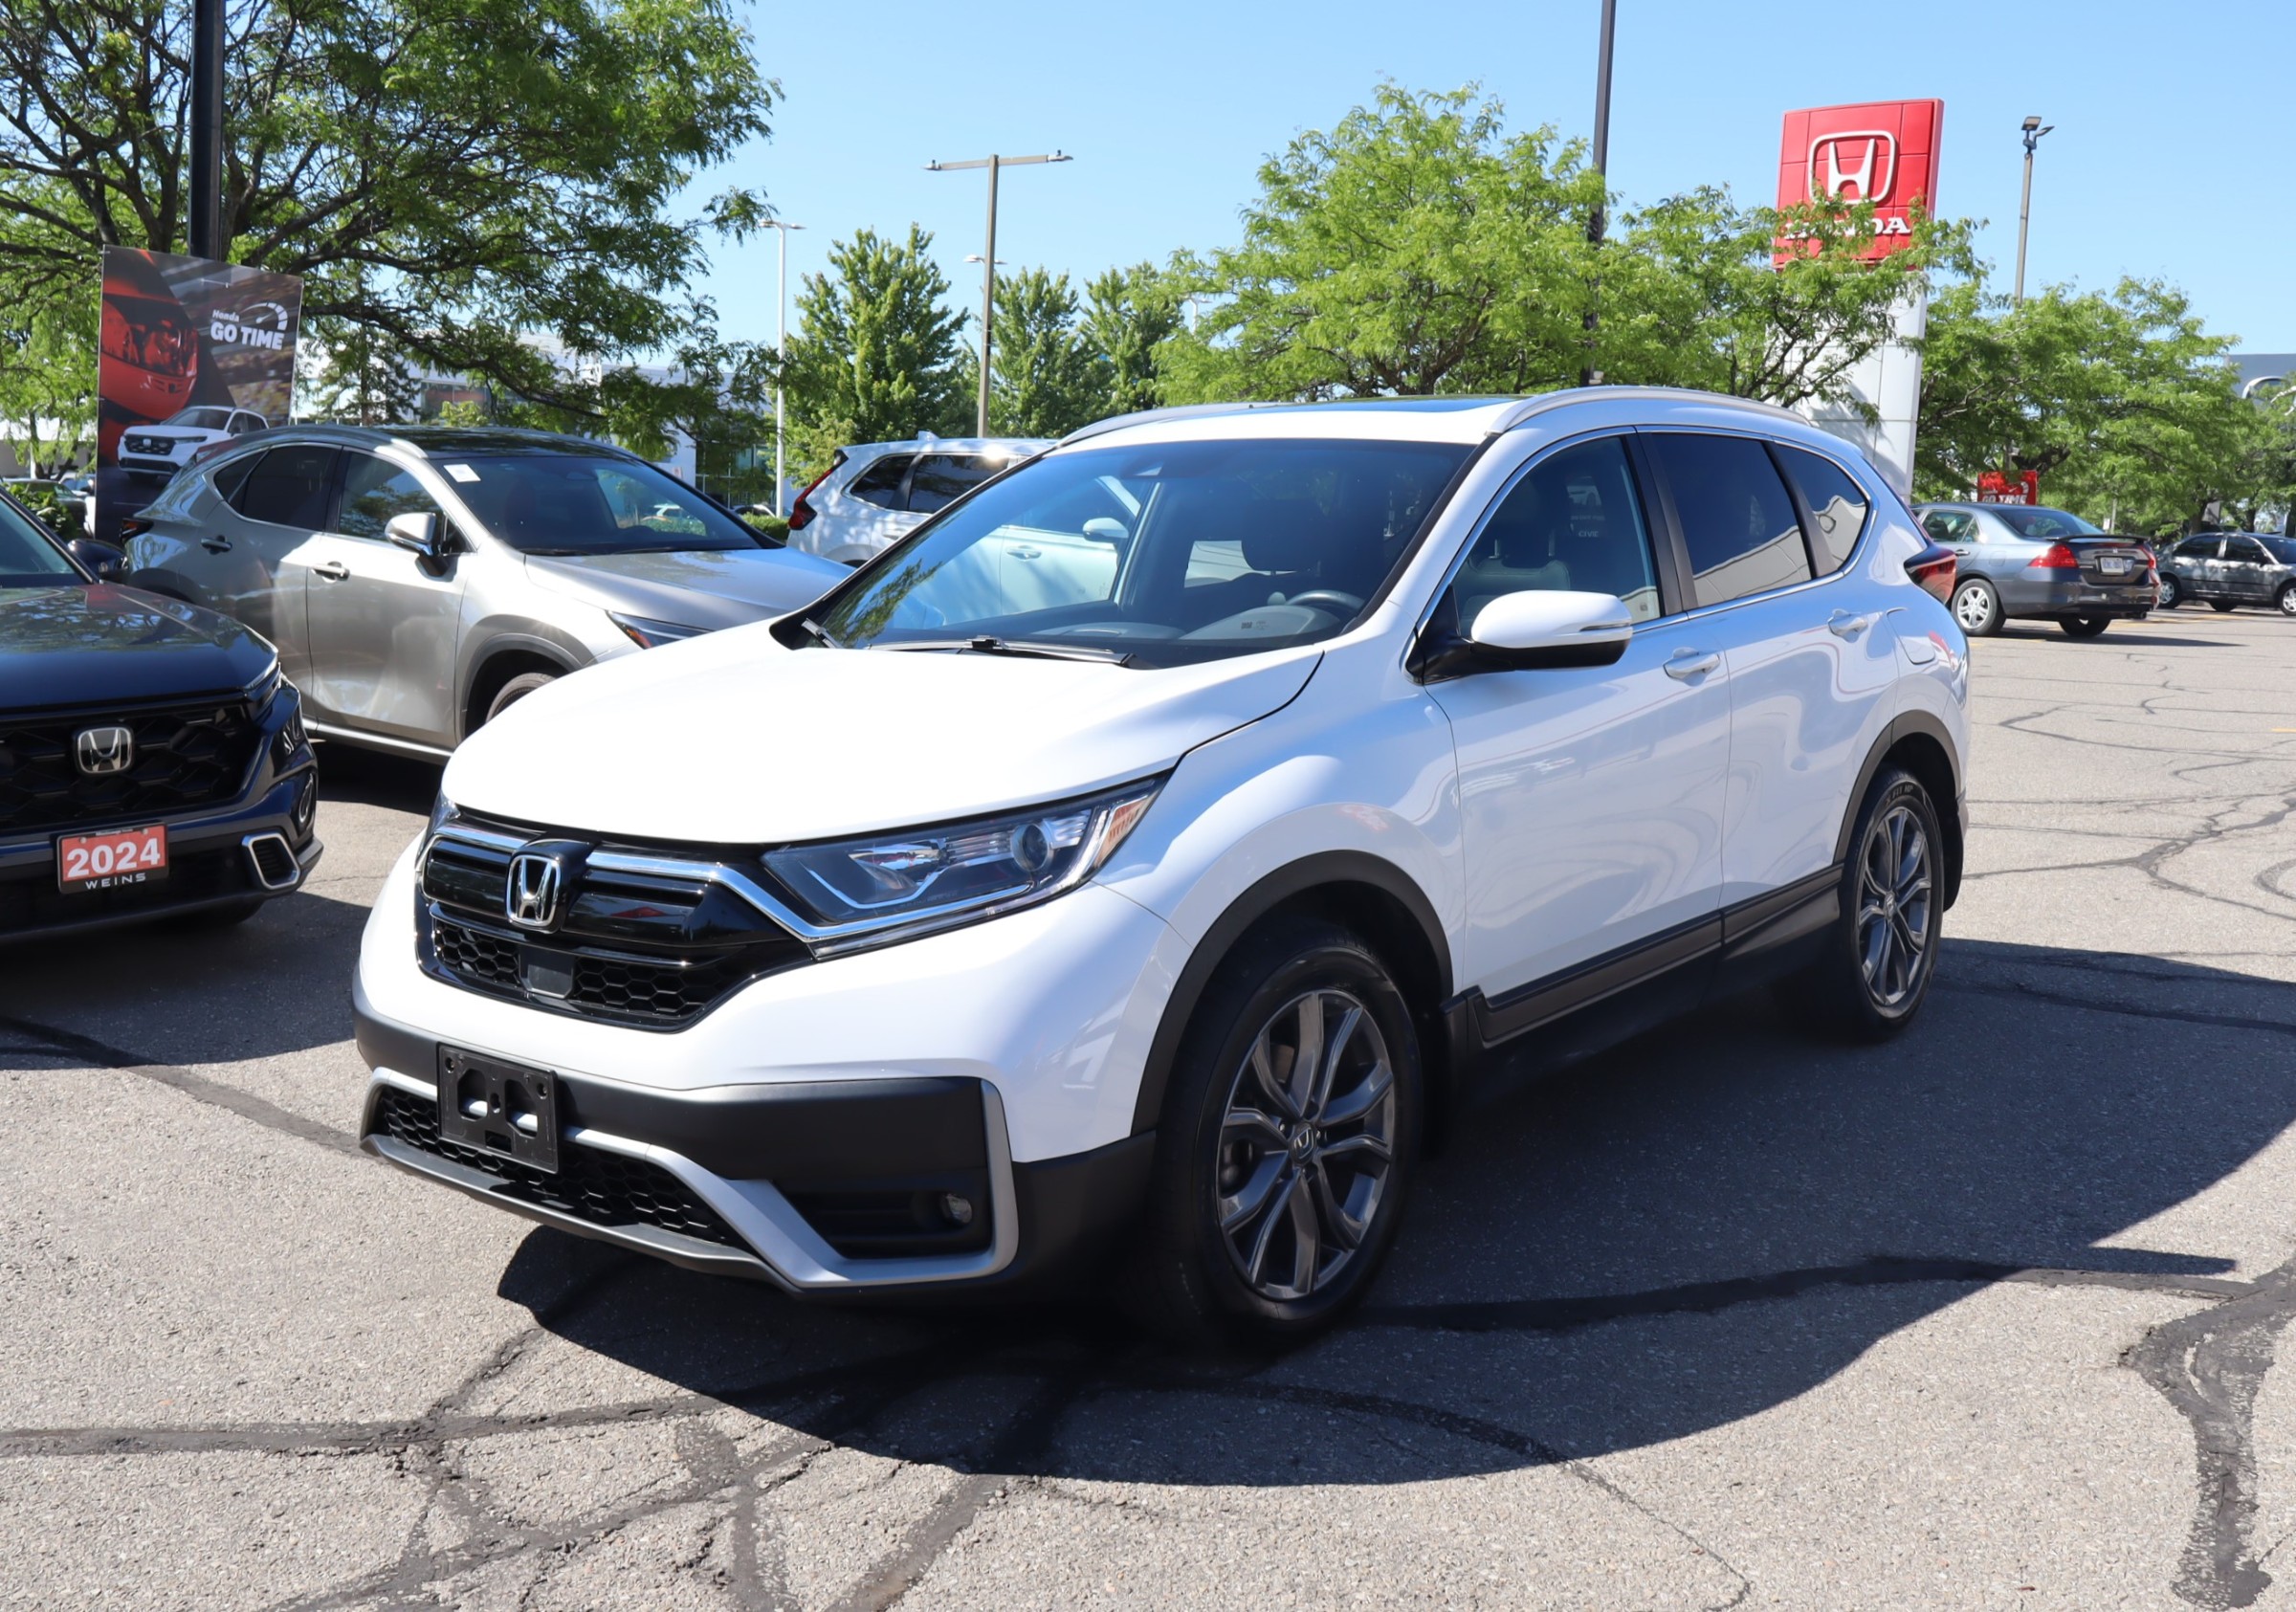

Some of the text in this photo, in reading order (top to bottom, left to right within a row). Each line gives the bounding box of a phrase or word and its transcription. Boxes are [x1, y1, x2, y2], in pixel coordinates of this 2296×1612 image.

[212, 309, 240, 322] Honda
[210, 320, 285, 351] GO TIME
[67, 837, 161, 878] 2024
[85, 872, 146, 890] WEINS
